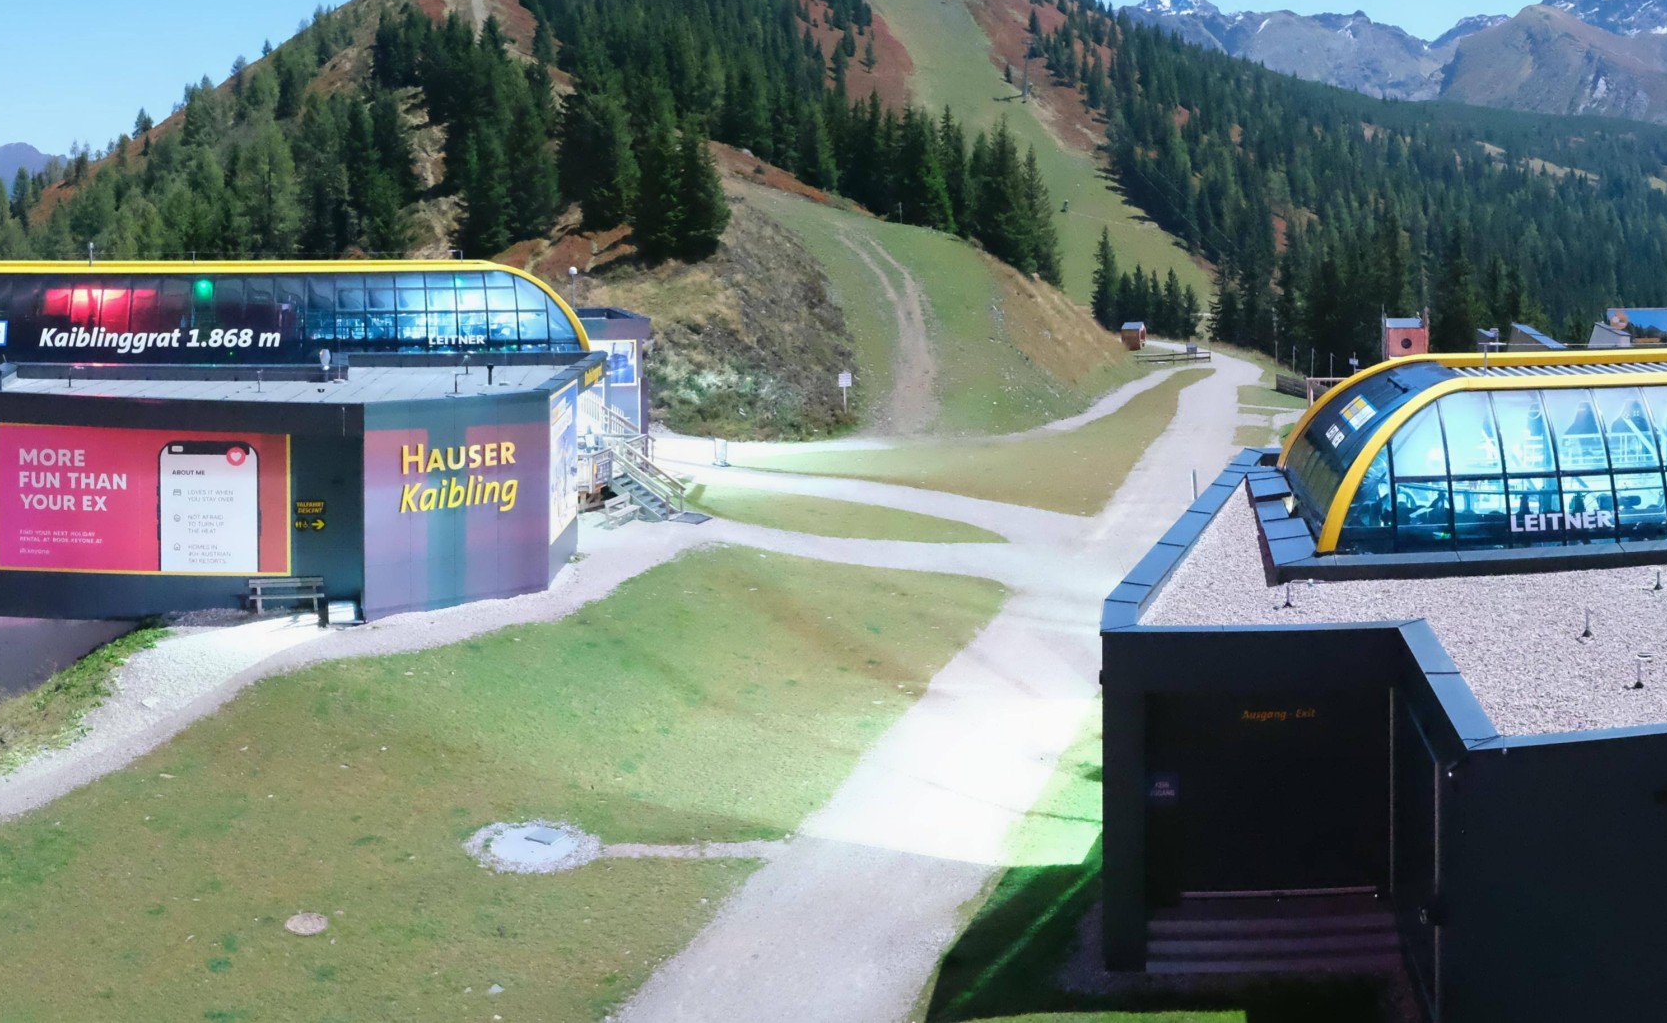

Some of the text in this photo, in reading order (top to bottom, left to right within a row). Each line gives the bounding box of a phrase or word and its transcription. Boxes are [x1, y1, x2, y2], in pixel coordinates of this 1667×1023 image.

[39, 327, 281, 354] Kaiblinggrat 1.868 m
[428, 335, 485, 345] LEITNER
[18, 448, 86, 467] MORE
[401, 441, 516, 475] HAUSER
[18, 471, 128, 490] FUN THAN
[20, 493, 108, 512] YOUR EX
[400, 475, 519, 514] Kaibling
[1510, 510, 1614, 533] LEITNER
[1241, 709, 1288, 722] Ausgang
[1295, 708, 1316, 718] Exit
